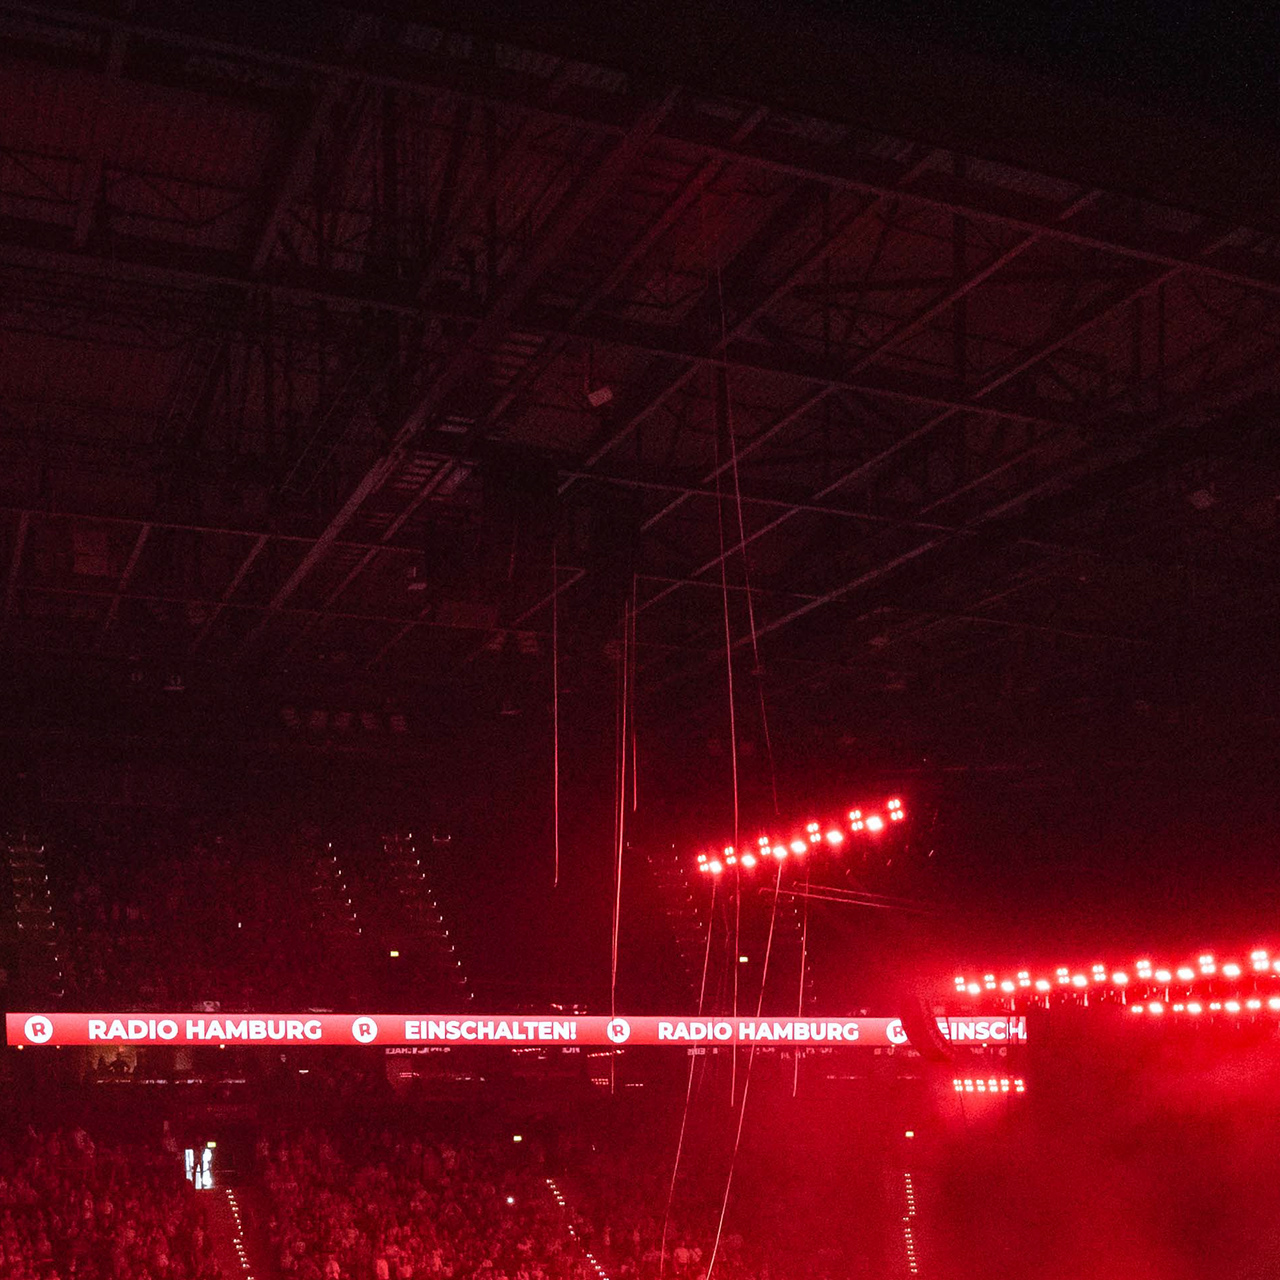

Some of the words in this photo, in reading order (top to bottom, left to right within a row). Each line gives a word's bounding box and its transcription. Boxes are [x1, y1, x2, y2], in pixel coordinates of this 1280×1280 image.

[88, 1019, 179, 1040] RADIO
[185, 1019, 322, 1040] HAMBURG
[404, 1020, 577, 1040] EINSCHALTEN!
[658, 1021, 733, 1041] RADIO
[738, 1021, 860, 1041] HAMBURG
[937, 1020, 1027, 1041] EINSCH
